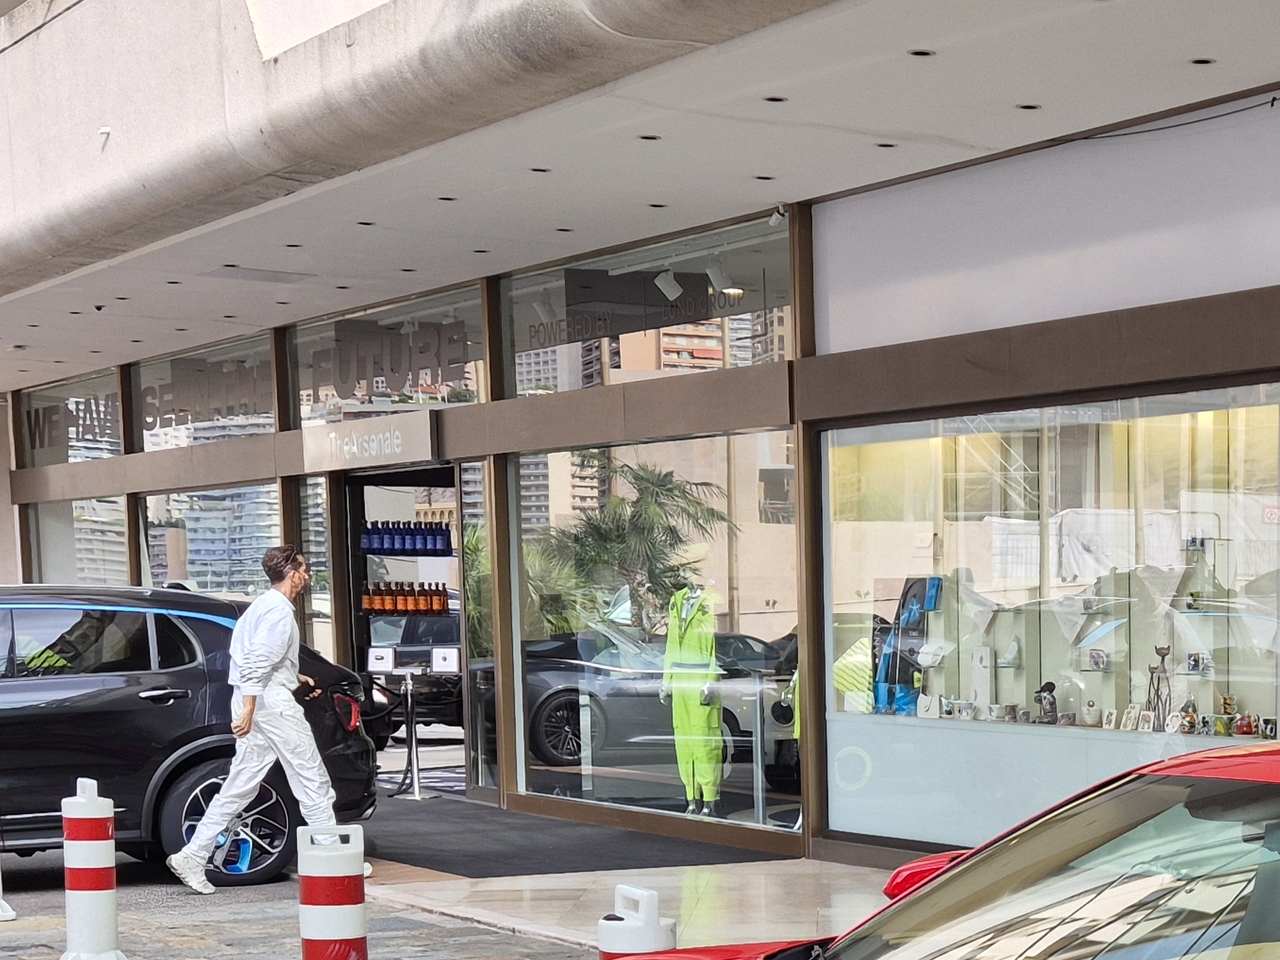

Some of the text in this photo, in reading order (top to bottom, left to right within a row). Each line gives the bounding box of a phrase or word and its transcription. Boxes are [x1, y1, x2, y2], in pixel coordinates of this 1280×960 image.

[529, 291, 745, 347] POWERED BY LUND GROUP
[26, 405, 60, 451] WE
[312, 319, 467, 404] FUTURE
[328, 426, 402, 462] TheArsenale
